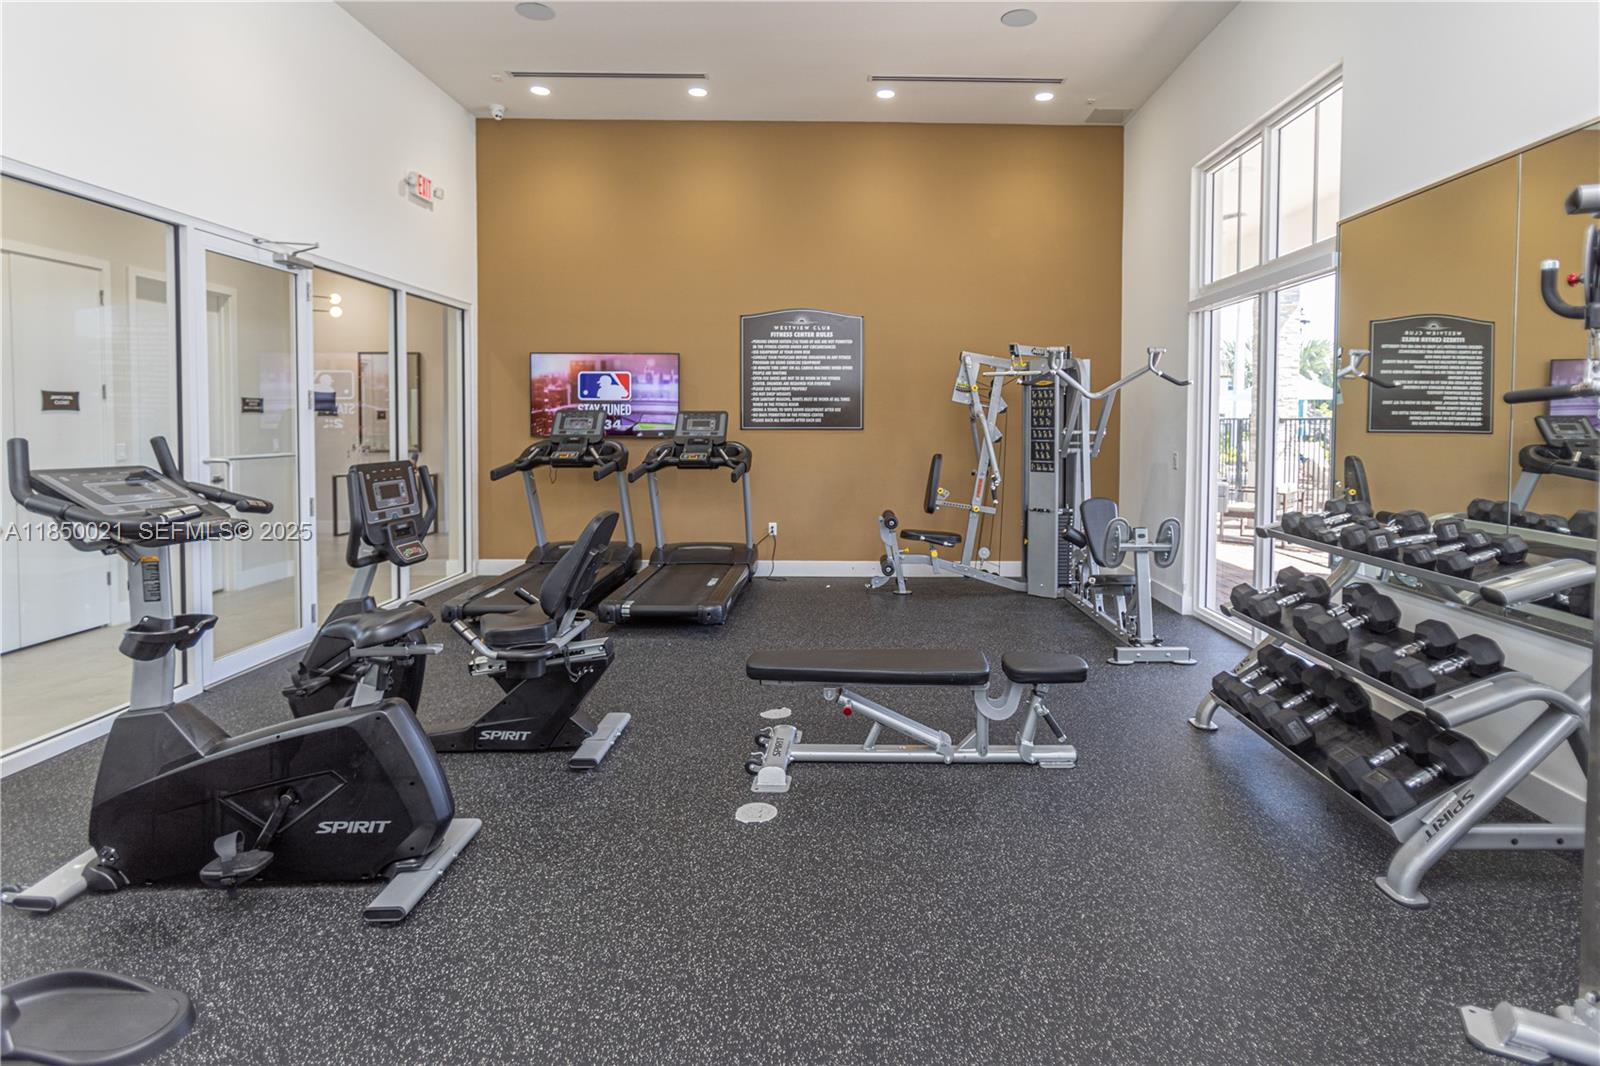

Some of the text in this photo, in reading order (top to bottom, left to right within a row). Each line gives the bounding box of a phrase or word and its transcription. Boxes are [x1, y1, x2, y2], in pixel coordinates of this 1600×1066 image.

[417, 174, 432, 200] EXIT
[478, 730, 532, 741] SPIRIT
[772, 737, 784, 757] SPIRIT
[1424, 788, 1476, 842] SPIRIT
[315, 820, 392, 834] SPIRIT
